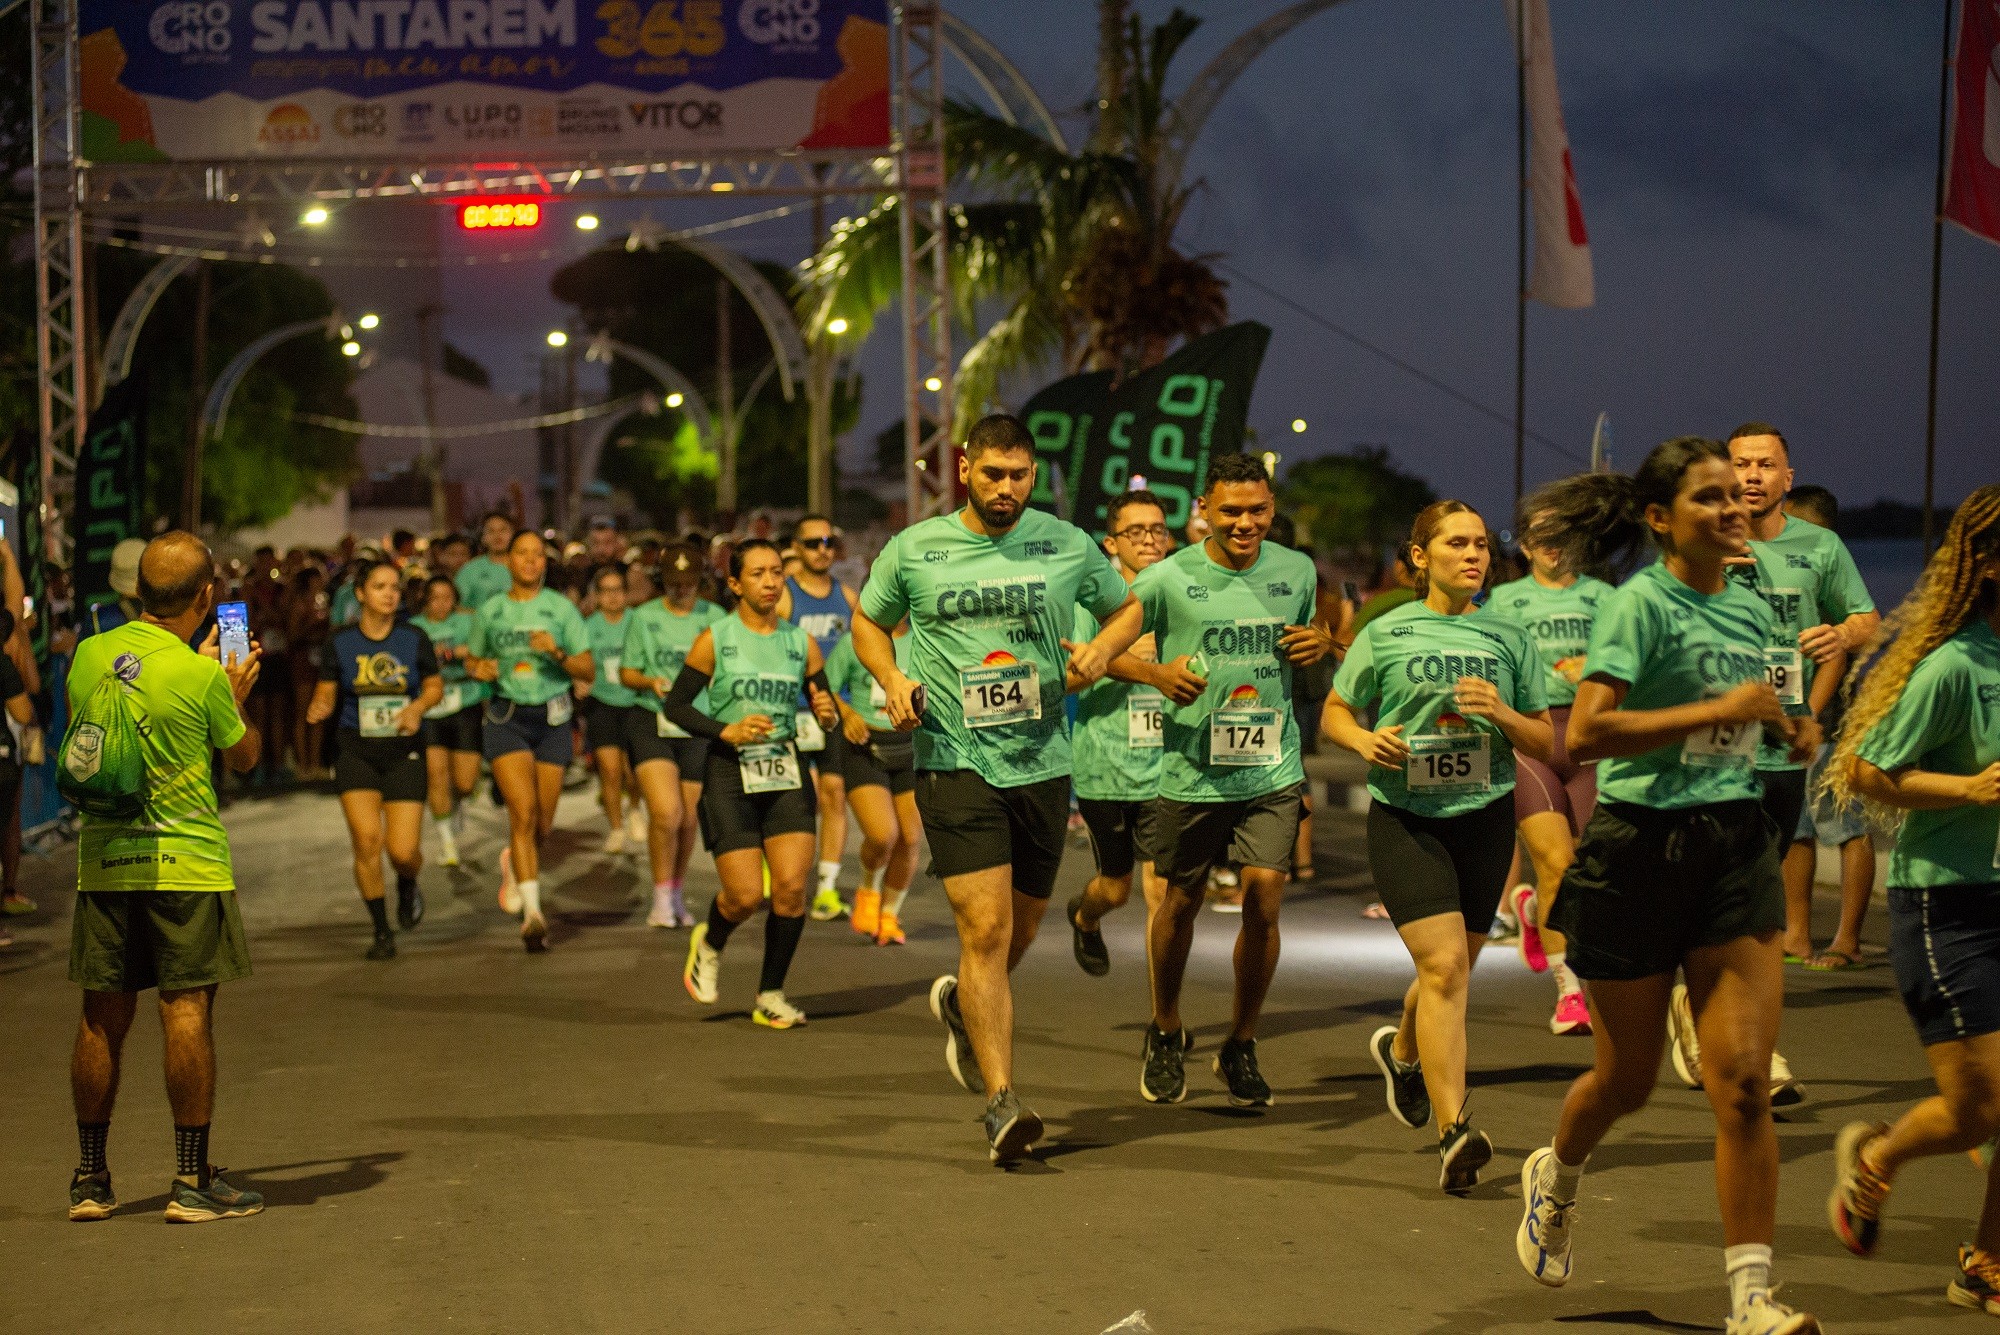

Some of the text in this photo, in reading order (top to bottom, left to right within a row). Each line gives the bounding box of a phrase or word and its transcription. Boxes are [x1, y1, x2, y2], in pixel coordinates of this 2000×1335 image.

[596, 0, 727, 56] 365
[445, 104, 522, 125] LUPO
[628, 101, 723, 129] VITOR
[1138, 374, 1209, 530] UPO
[937, 582, 1047, 621] CORRE
[1001, 668, 1026, 679] 10KM
[731, 678, 799, 703] CORRE
[977, 681, 1024, 708] 164
[1250, 714, 1271, 723] 10KM
[1226, 726, 1265, 748] 174
[754, 758, 785, 777] 176
[1425, 752, 1472, 778] 165
[101, 854, 151, 869] Santarém
[161, 853, 176, 864] Pa
